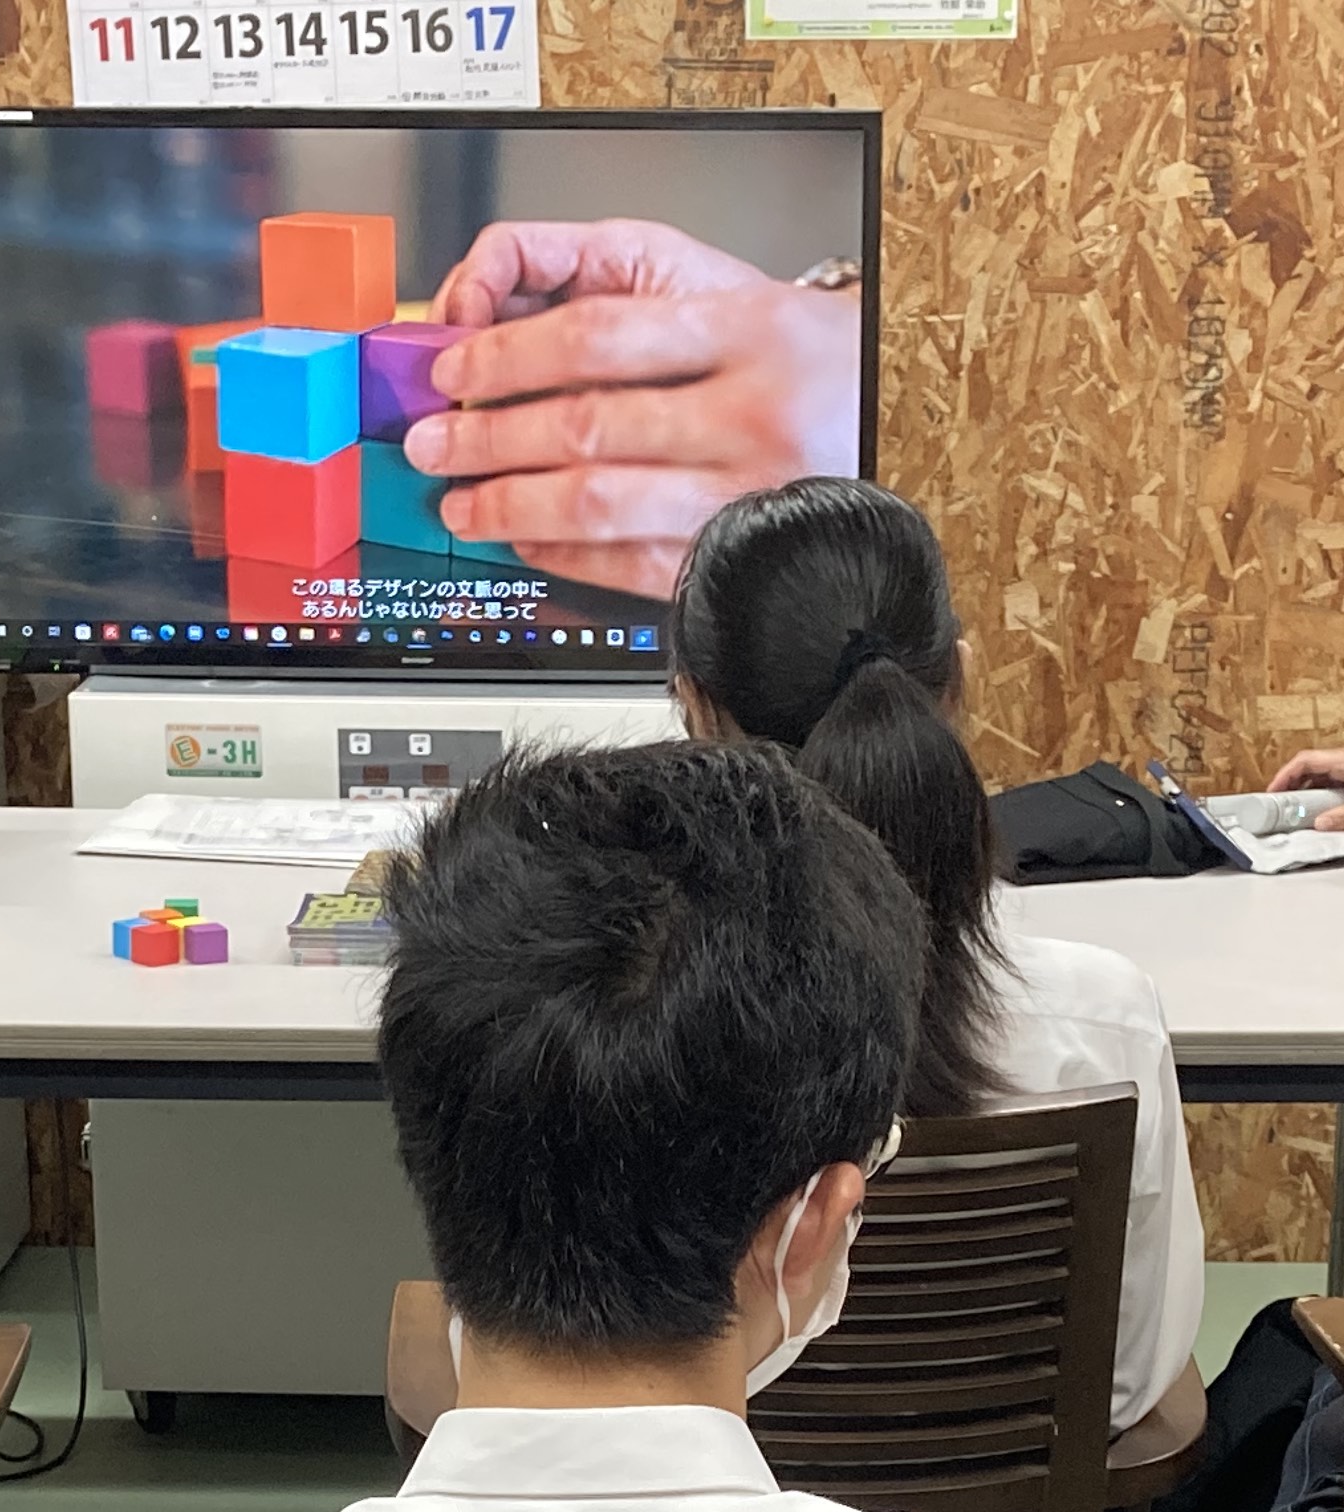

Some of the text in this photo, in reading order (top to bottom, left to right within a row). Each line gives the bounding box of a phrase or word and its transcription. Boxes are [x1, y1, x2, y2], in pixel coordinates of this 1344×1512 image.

[89, 5, 515, 62] 11 12 13 14 15 16 17
[302, 600, 538, 620] あるんじゃないかなと思って
